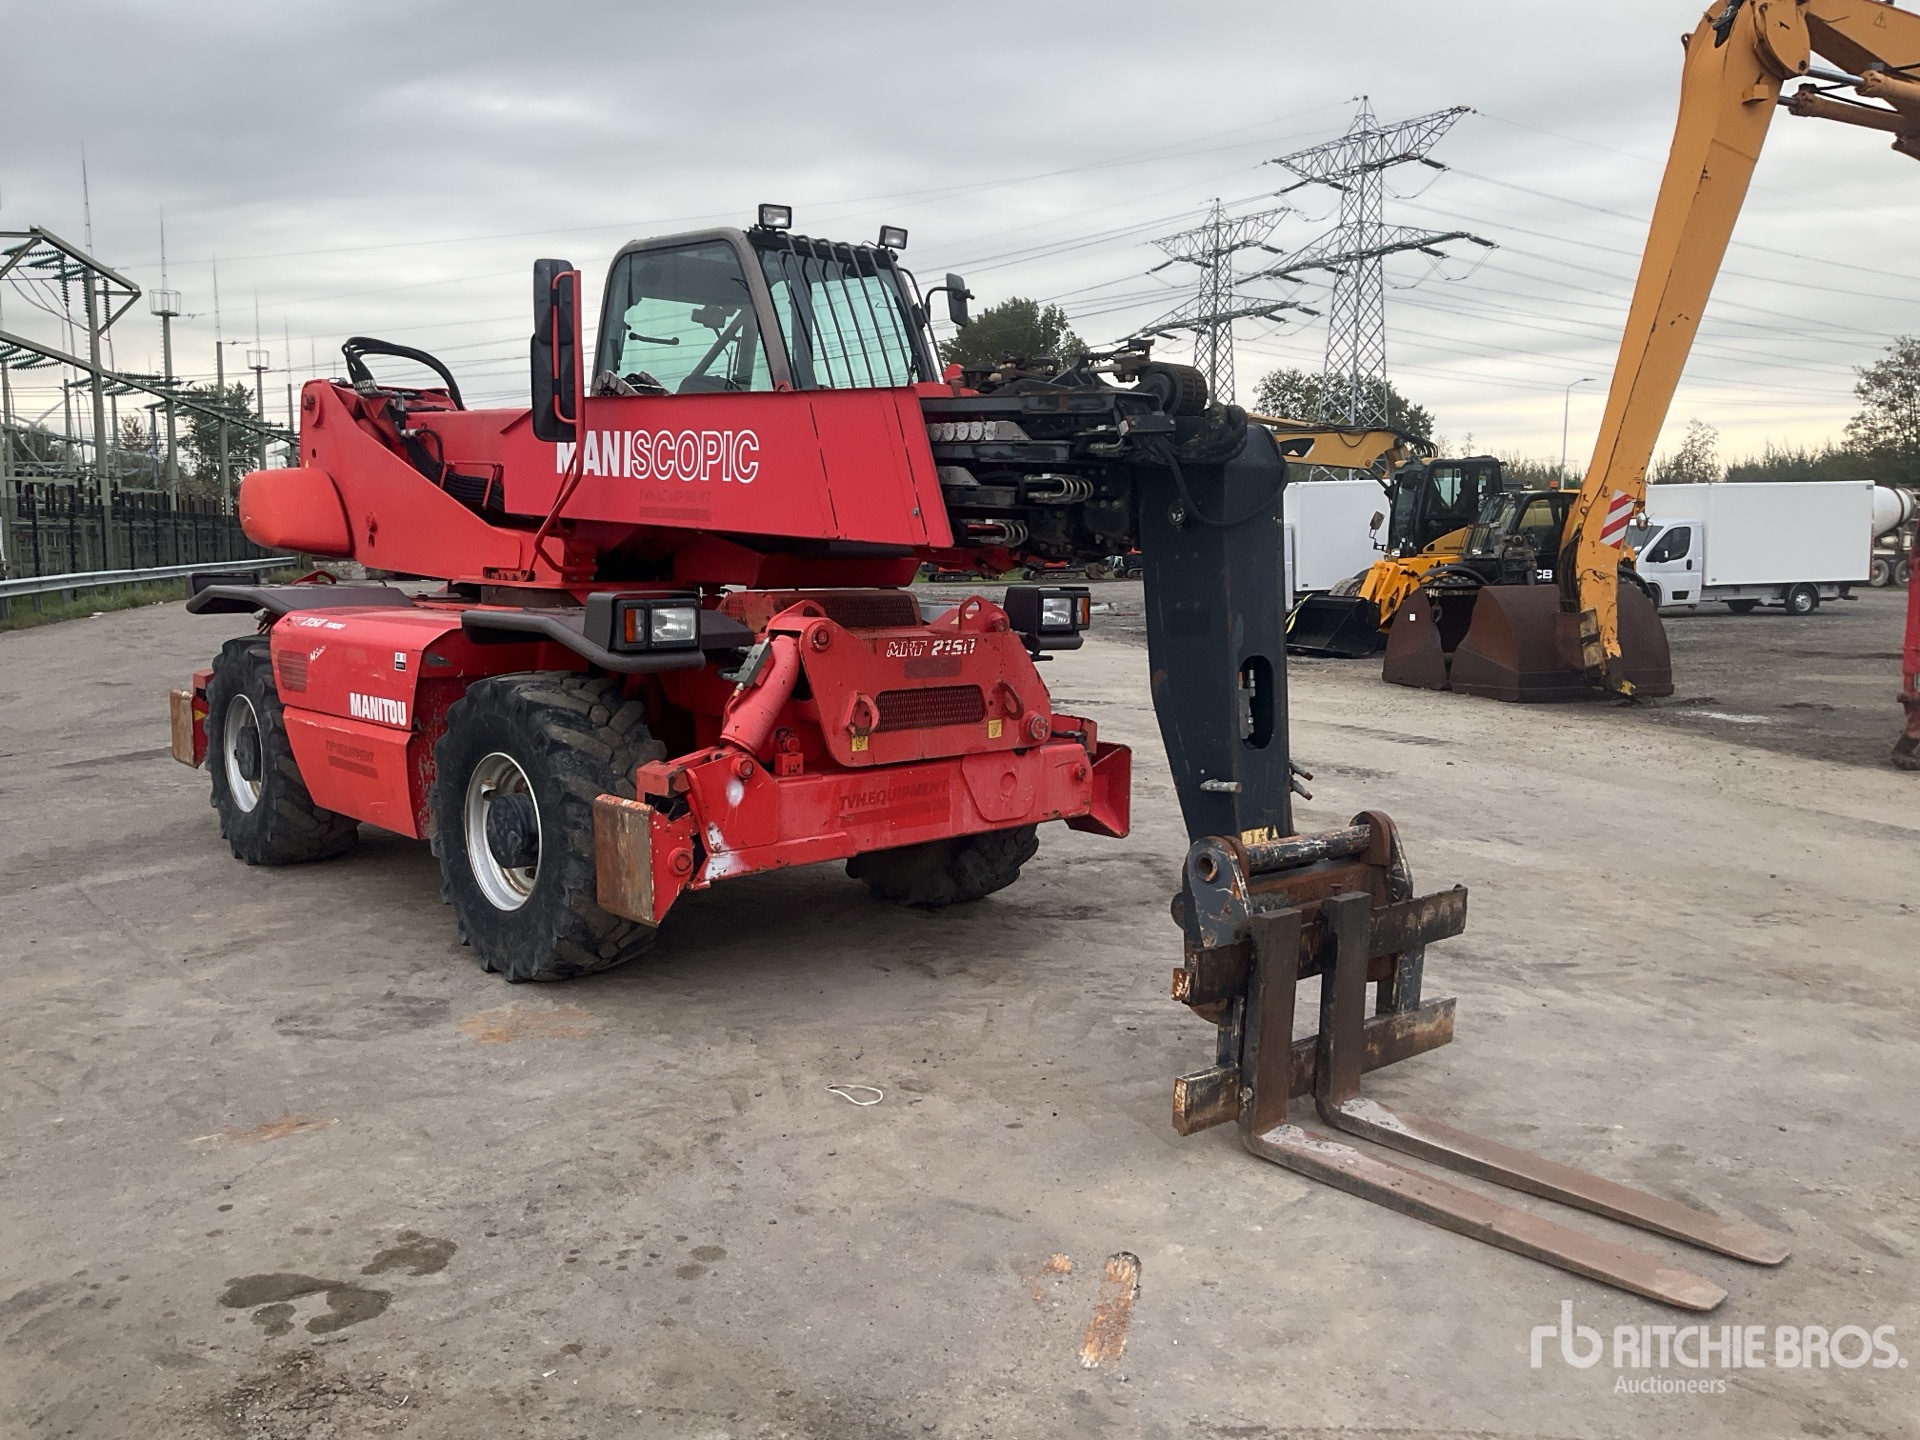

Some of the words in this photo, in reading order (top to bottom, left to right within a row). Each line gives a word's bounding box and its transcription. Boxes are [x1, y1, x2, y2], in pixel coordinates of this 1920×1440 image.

[556, 429, 760, 484] MANISCOPIC
[1536, 569, 1553, 580] CB
[350, 692, 407, 727] MANITOU
